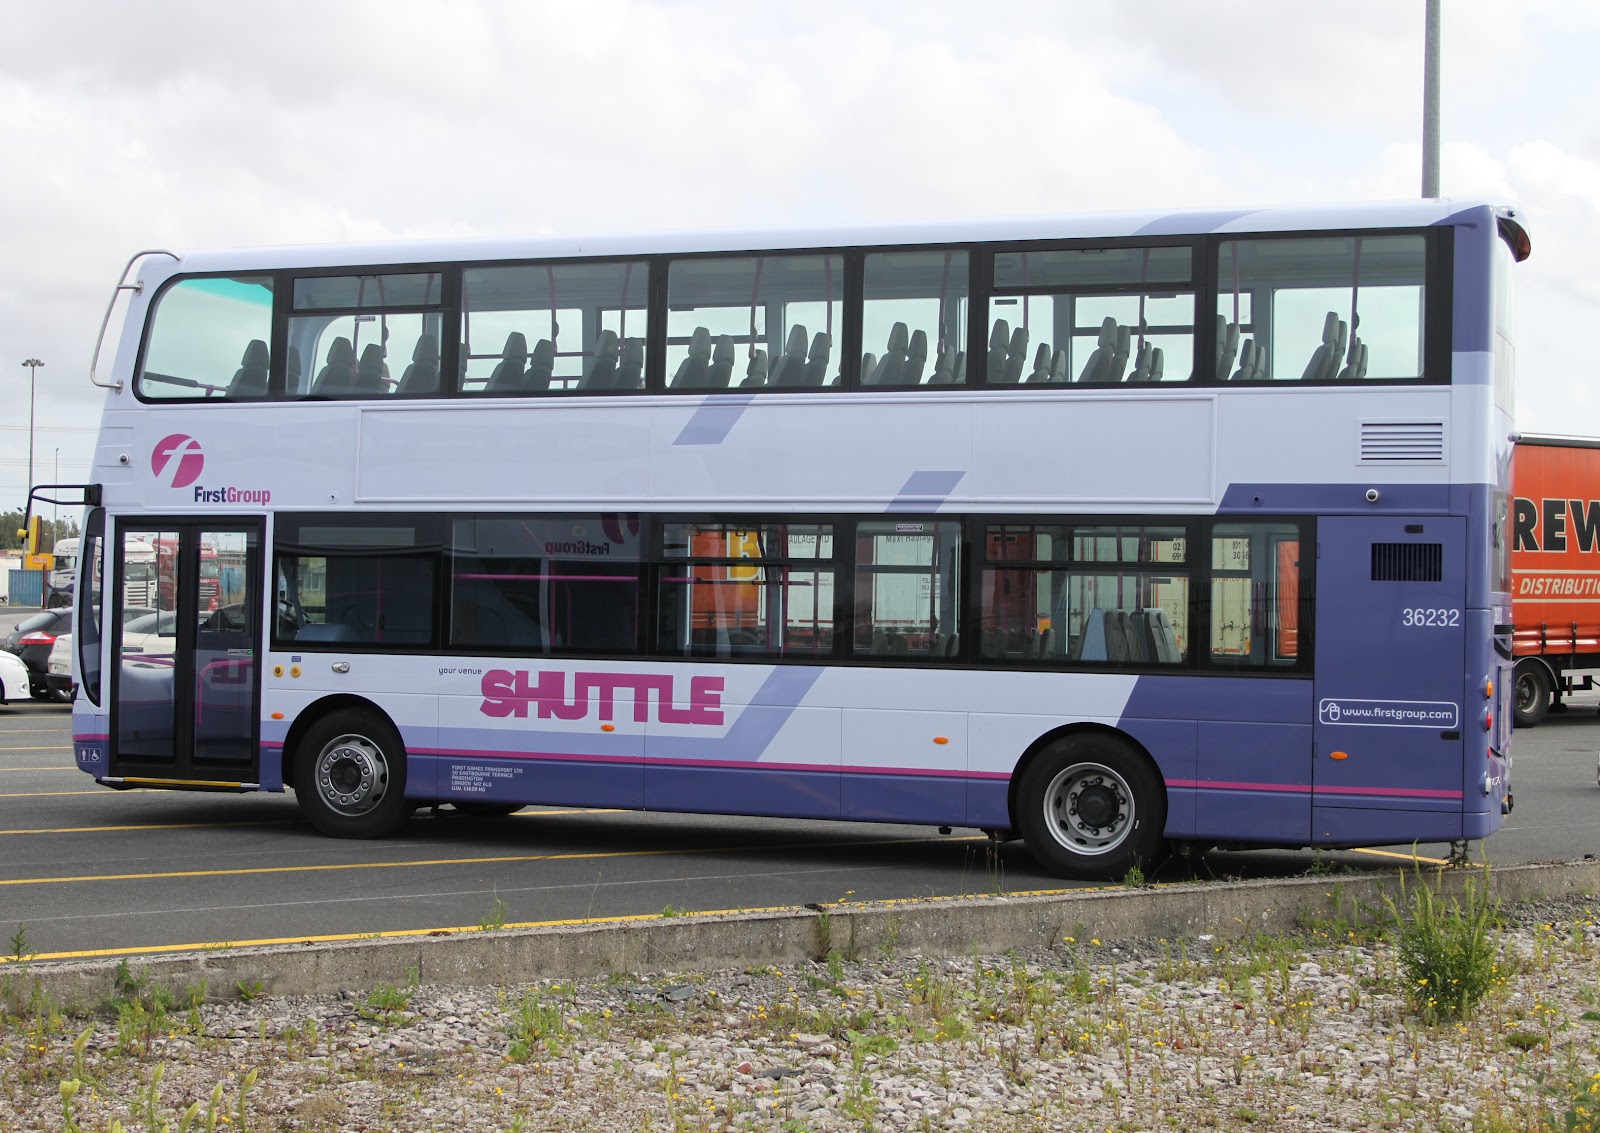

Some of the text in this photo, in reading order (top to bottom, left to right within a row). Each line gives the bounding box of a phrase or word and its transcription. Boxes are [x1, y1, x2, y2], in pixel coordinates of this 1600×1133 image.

[194, 486, 271, 506] FirstGroup
[1402, 608, 1460, 627] 36232
[438, 667, 457, 676] your
[479, 669, 725, 726] SHUTTLE
[1342, 707, 1453, 720] www.firstgroup.com
